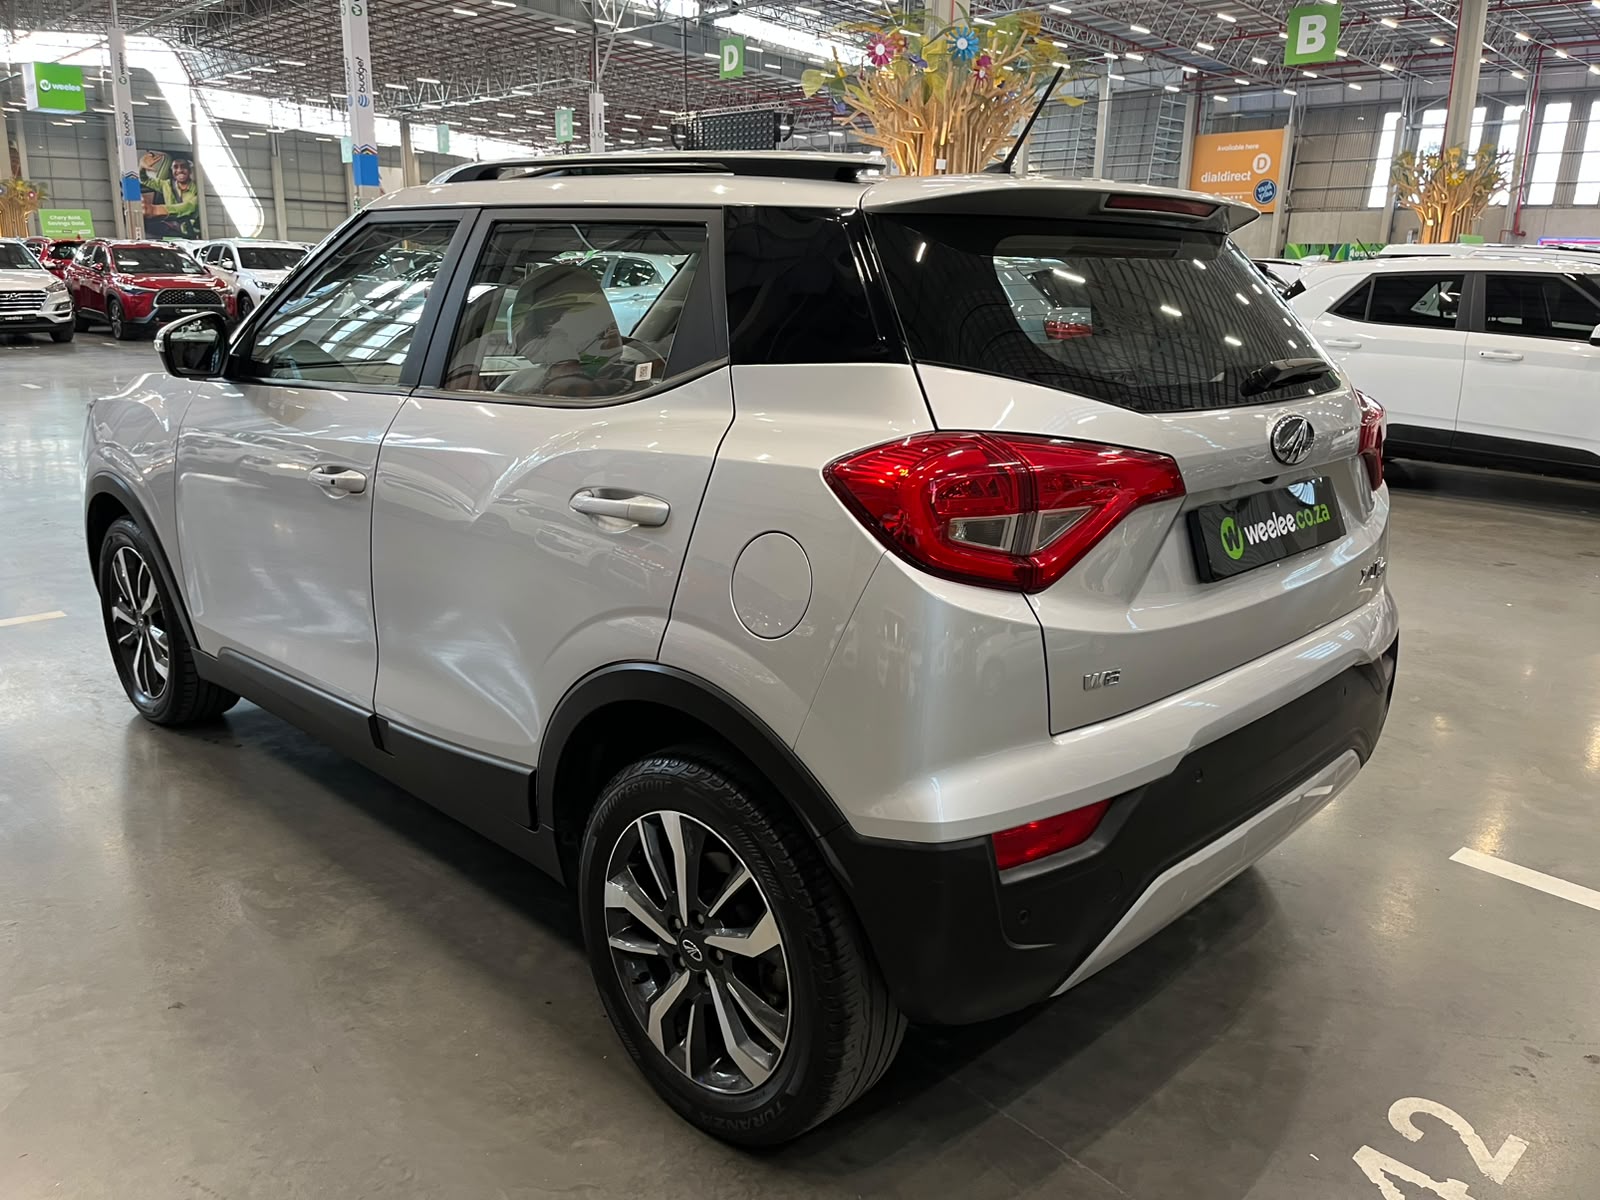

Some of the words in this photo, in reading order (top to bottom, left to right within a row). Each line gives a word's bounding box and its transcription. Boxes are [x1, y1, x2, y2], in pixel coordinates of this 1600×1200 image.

[1295, 14, 1327, 55] B
[723, 44, 739, 72] D
[51, 83, 81, 92] weelee
[355, 56, 368, 94] budget
[1216, 144, 1244, 152] Available
[1200, 170, 1252, 183] dialdirect
[1244, 503, 1331, 545] weelee.co.za
